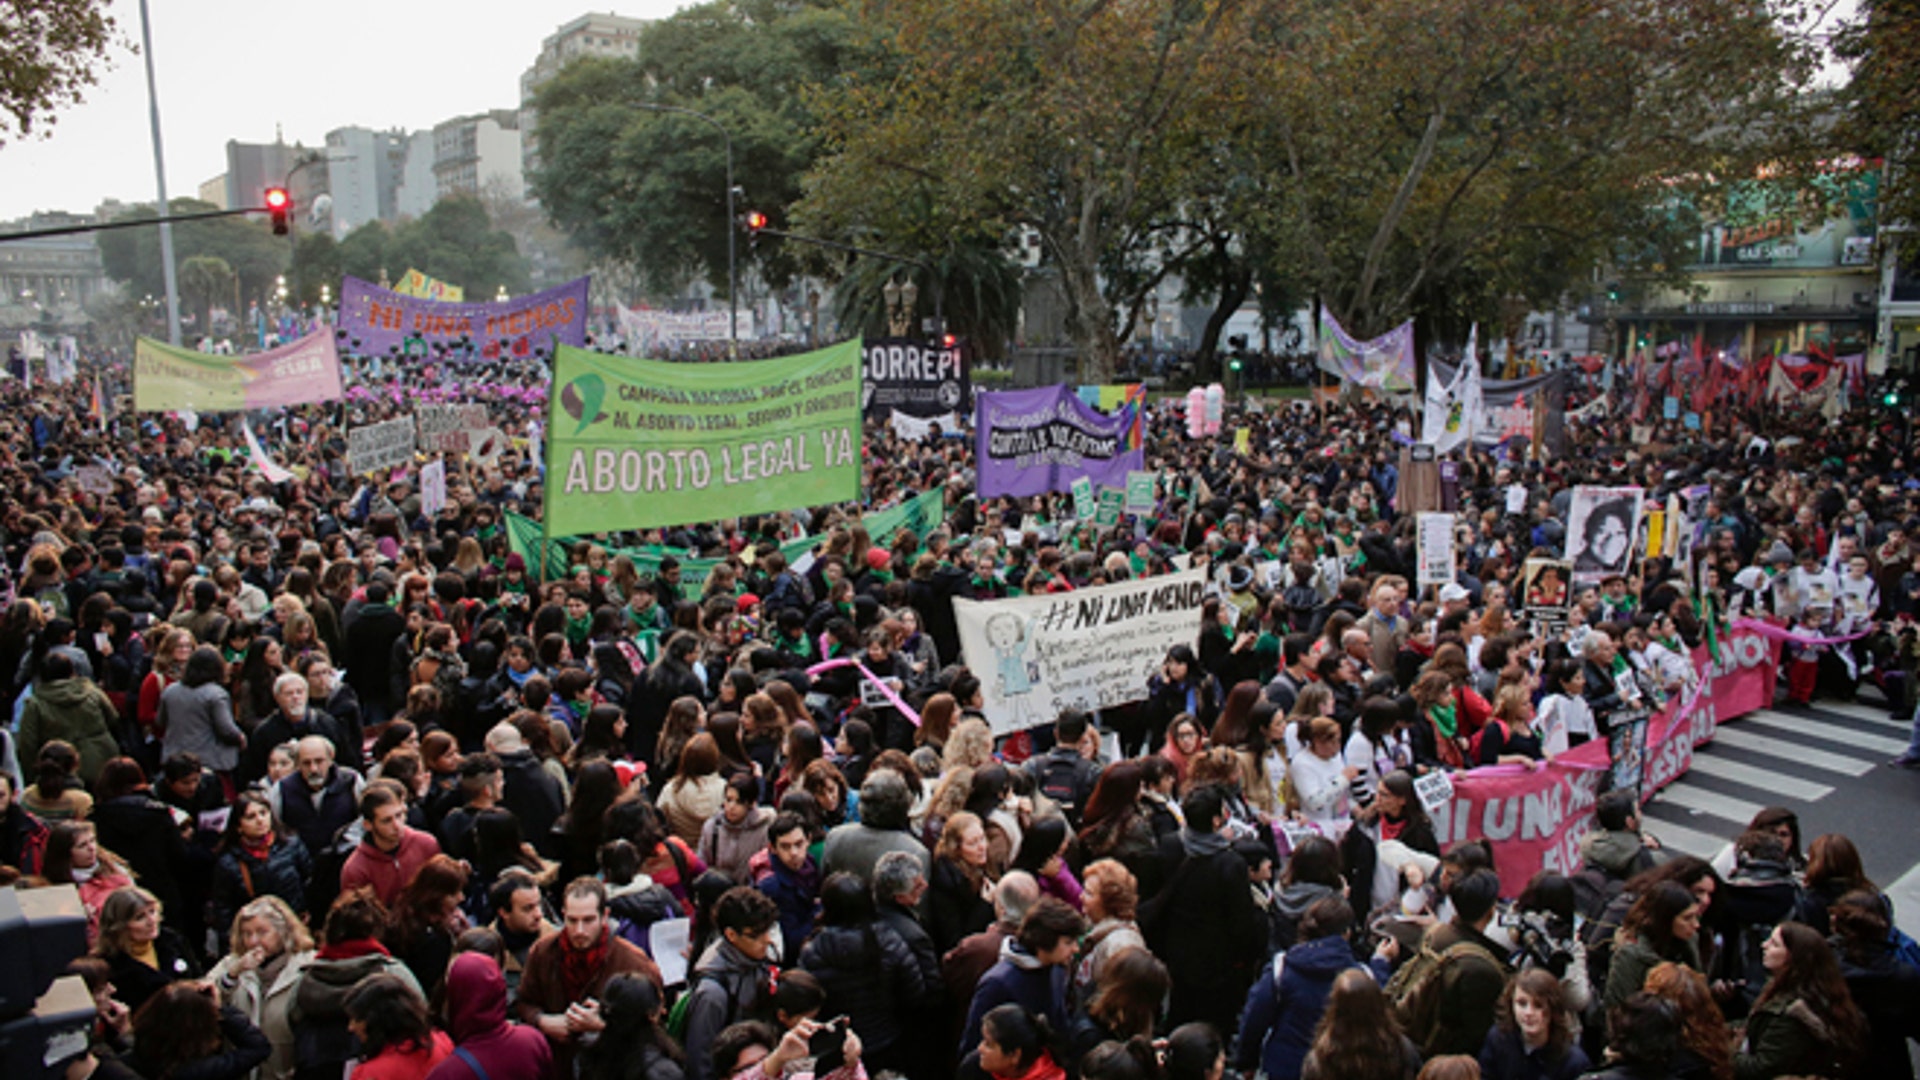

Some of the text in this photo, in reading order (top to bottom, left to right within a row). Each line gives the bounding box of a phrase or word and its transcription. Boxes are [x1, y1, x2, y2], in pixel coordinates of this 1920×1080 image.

[368, 297, 577, 337] NI UNA MENOS
[636, 411, 696, 431] ABORTO
[564, 427, 856, 494] ABORTO LEGAL YA
[1148, 580, 1203, 615] MENO
[1482, 782, 1564, 841] UNA
